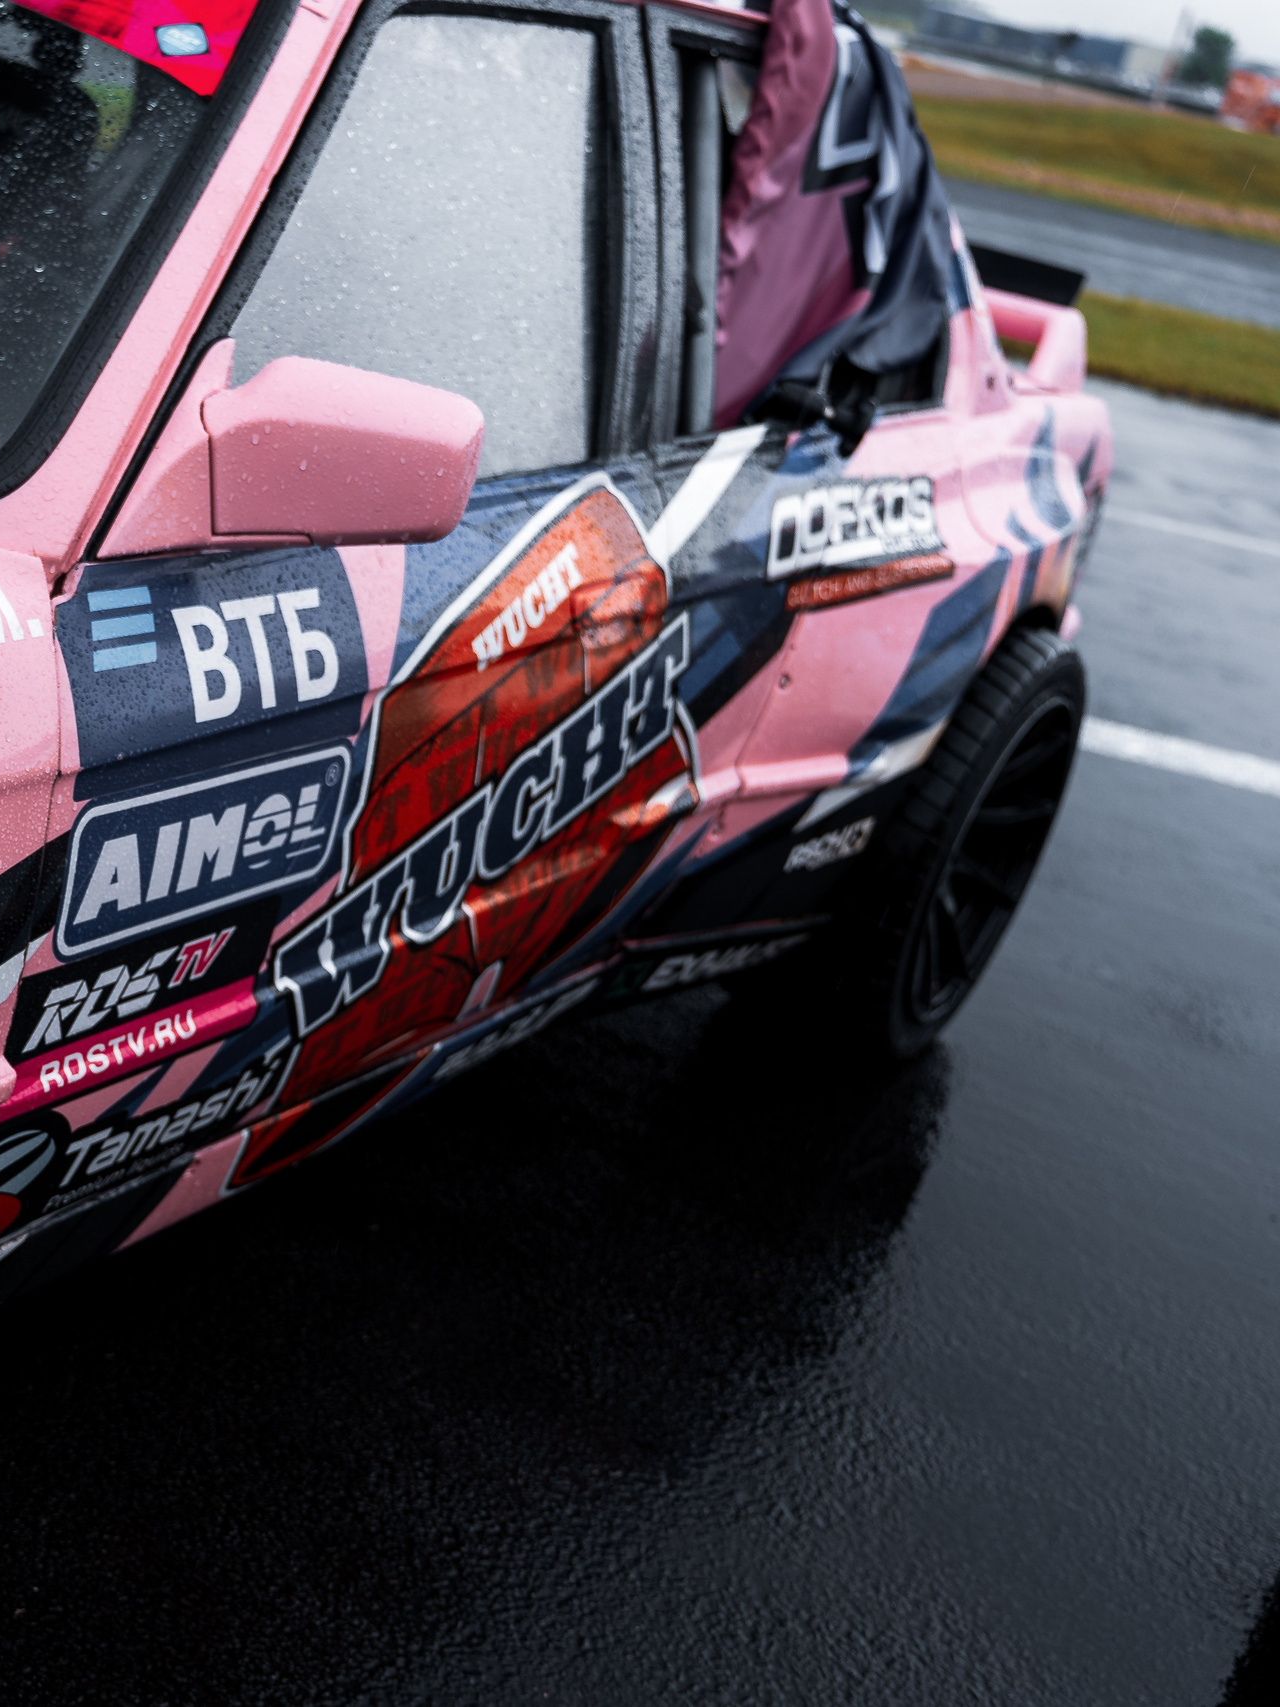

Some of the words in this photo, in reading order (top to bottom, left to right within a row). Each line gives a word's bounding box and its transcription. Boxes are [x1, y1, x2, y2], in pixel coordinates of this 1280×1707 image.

[170, 587, 340, 724] ВТБ
[471, 541, 584, 672] WUCHT
[72, 783, 326, 926] AIMOL
[273, 608, 693, 1038] WUCHT
[22, 945, 180, 1053] RDS
[167, 925, 237, 989] TV
[38, 1009, 198, 1094] RDSTV.RU
[59, 1057, 281, 1189] Tamashi
